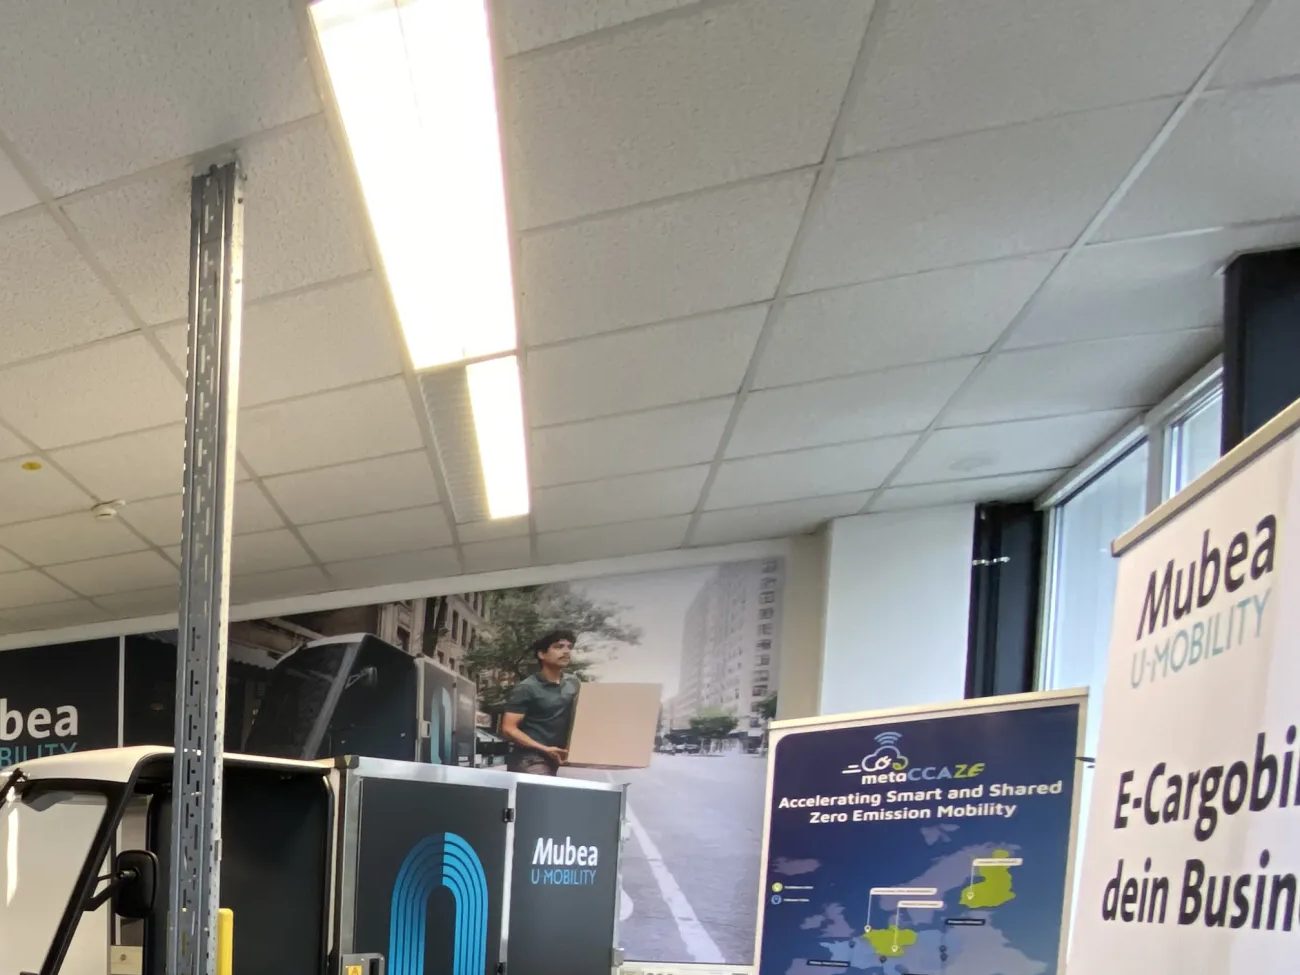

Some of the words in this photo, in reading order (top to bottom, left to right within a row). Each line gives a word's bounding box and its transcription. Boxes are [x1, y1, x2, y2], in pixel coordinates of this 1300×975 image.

[1136, 513, 1277, 642] Mubea
[778, 791, 881, 809] Accelerating
[886, 787, 942, 804] Smart
[947, 784, 984, 799] and
[989, 780, 1063, 797] Shared
[1113, 724, 1300, 842] E-Cargobi
[810, 810, 848, 824] Zero
[852, 806, 931, 823] Emission
[937, 802, 1018, 819] Mobility
[532, 836, 598, 866] Mubea
[1102, 856, 1170, 924] dein
[1177, 849, 1300, 932] Busin
